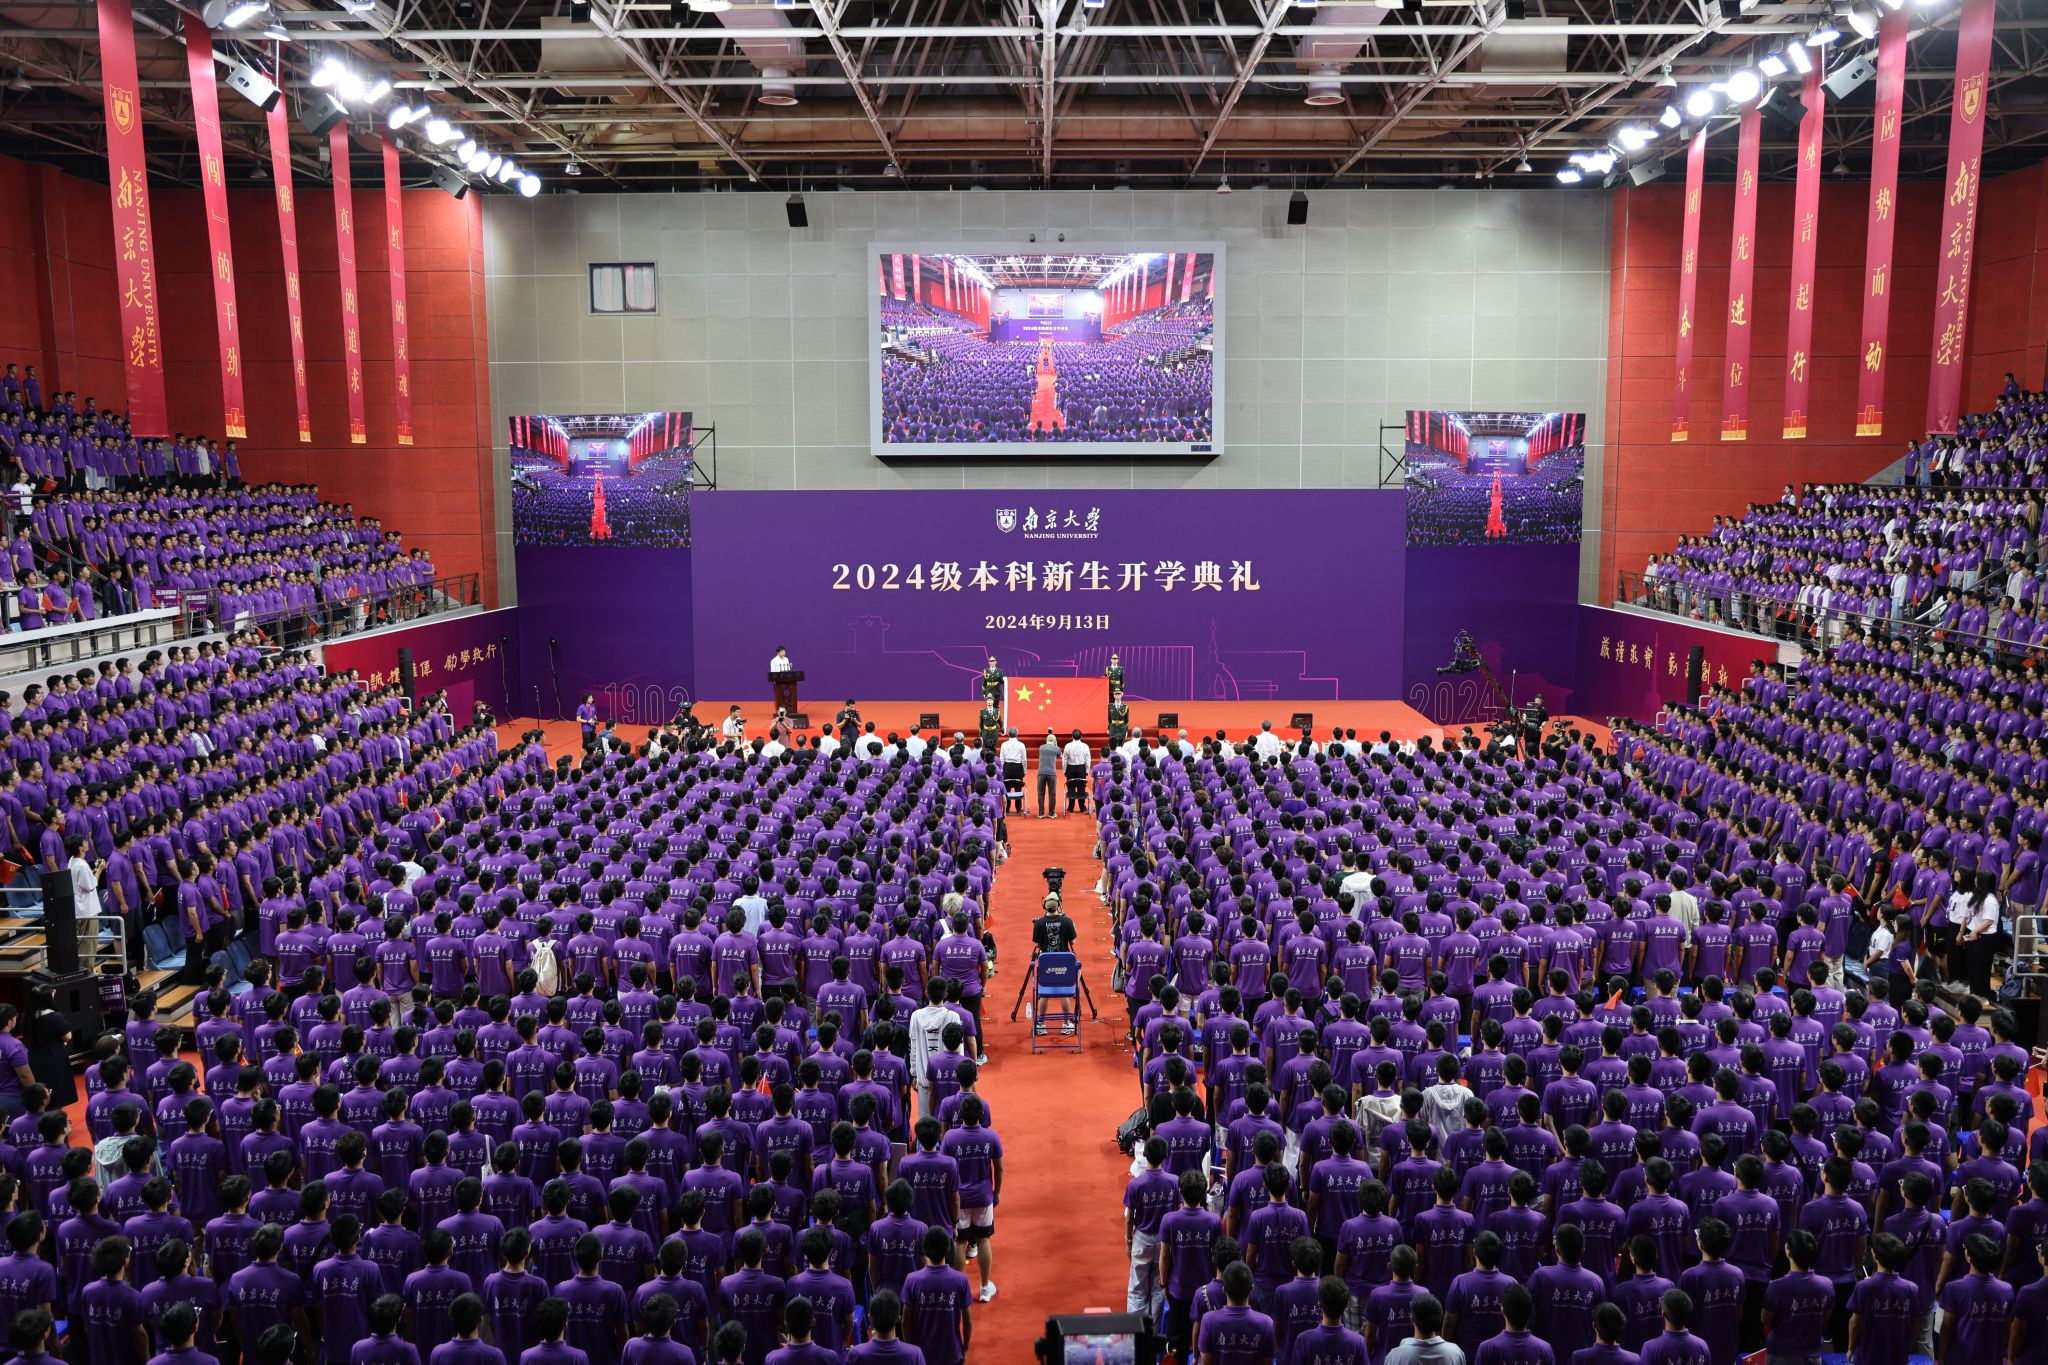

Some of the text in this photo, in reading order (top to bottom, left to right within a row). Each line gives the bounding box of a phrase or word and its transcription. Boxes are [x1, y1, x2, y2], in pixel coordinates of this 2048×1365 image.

[131, 170, 158, 368] NANJING UNIVERSITY
[1678, 191, 1699, 393] 团结奋斗
[1729, 168, 1753, 388] 争先进位
[1790, 142, 1817, 385] 坐言起行
[1865, 109, 1896, 374] 应势而动
[1953, 157, 1980, 364] NANJING UNIVERSITY
[831, 560, 1261, 592] 2024级本科新生开学典礼
[985, 613, 1111, 631] 2024年9月13日
[1409, 679, 1498, 726] 2024
